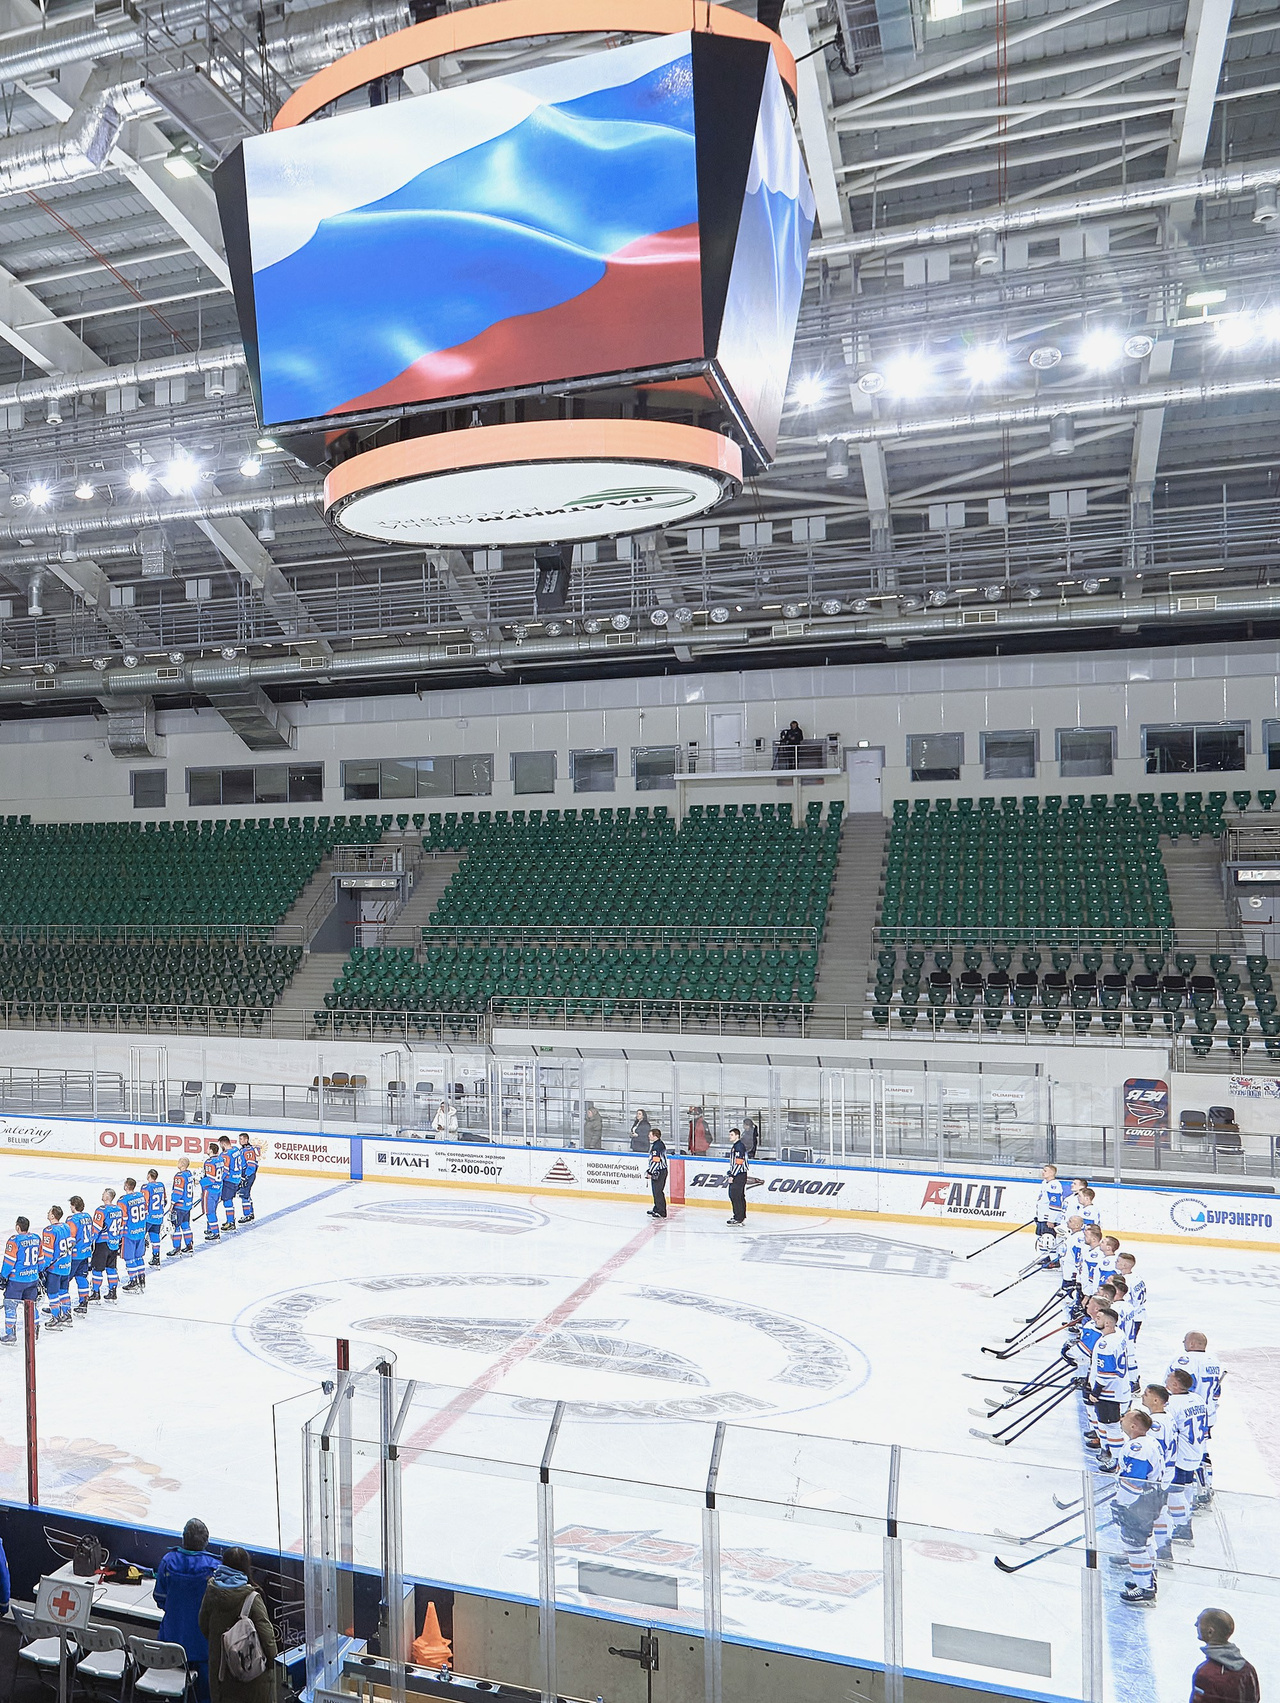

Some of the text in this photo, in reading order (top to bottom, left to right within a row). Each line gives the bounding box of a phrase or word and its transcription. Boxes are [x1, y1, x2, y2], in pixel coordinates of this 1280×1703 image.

[274, 1141, 328, 1153] ФЕДЕРАЦИЯ
[274, 1152, 350, 1165] ХОККЕЯ РОССИИ
[390, 1156, 429, 1168] ИЛАН
[450, 1164, 503, 1176] 2-000-007
[586, 1161, 640, 1171] НОВОАНГАРСКИЙ
[586, 1170, 642, 1179] ОБОГАТИТЕЛЬНЫЙ
[586, 1178, 620, 1186] КОМБИНАТ
[767, 1177, 846, 1197] СОКОЛ!
[946, 1183, 1007, 1209] АГАТ
[946, 1206, 1007, 1217] АВТОХОЛДИНГ
[1206, 1209, 1273, 1228] БУРЭНЕРГО
[23, 1246, 39, 1266] 16
